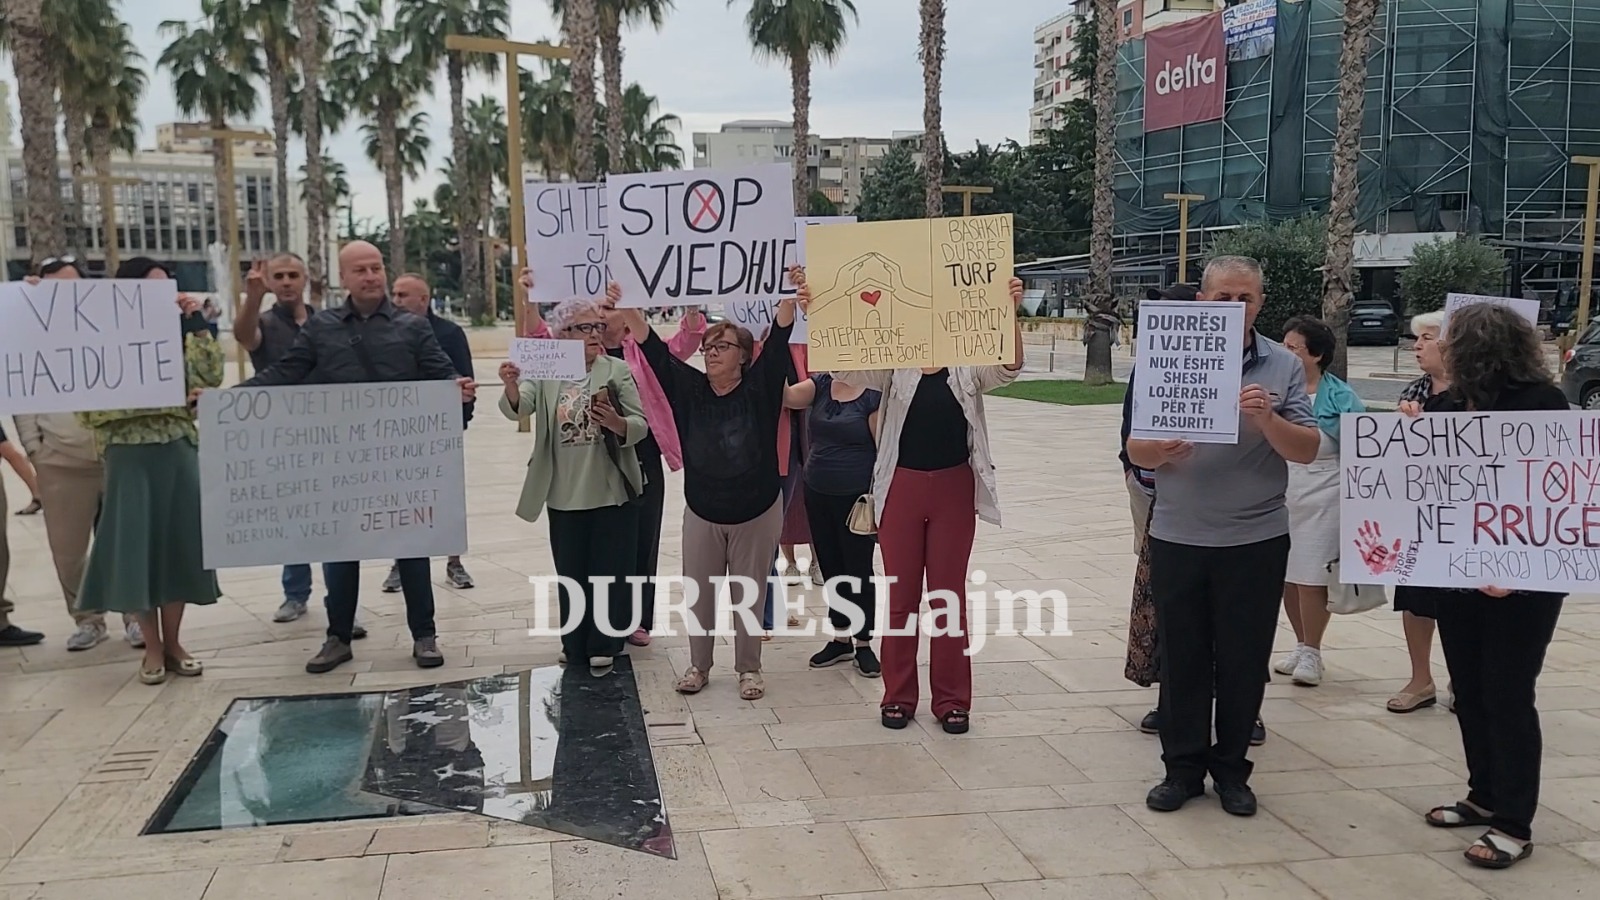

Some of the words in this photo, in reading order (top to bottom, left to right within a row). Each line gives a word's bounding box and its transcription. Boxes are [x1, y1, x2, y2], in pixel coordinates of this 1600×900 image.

[1155, 53, 1216, 95] delta
[619, 178, 763, 236] STOP
[948, 216, 1011, 242] BASHKIA
[624, 238, 797, 299] VJEDHJE
[944, 262, 997, 287] TURP
[938, 305, 1008, 333] VENDIMIN
[1147, 312, 1227, 331] DURRËSI
[860, 347, 894, 364] JETA
[951, 333, 1004, 361] TUAJ!
[1149, 335, 1154, 350] I
[1161, 333, 1227, 352] VJETËR
[5, 340, 173, 397] HAJDUTE
[1149, 357, 1179, 369] NUK
[1183, 355, 1225, 371] ËSHTË
[1163, 371, 1208, 384] SHESH
[217, 390, 272, 425] 200
[283, 391, 330, 415] VJET
[341, 386, 420, 411] HISTORI
[1149, 384, 1218, 400] LOJËRASH
[1161, 400, 1187, 414] PËR
[1190, 400, 1205, 414] TË
[1152, 415, 1214, 429] PASURIT!
[224, 430, 250, 453] PO
[260, 428, 265, 447] I
[349, 425, 367, 443] ME
[1356, 415, 1500, 464] BASHKI,
[1501, 422, 1535, 457] PO
[1545, 421, 1575, 457] NA
[225, 460, 257, 483] NJE
[334, 452, 341, 464] E
[347, 447, 399, 464] VJETER
[403, 443, 425, 459] NUK
[430, 437, 463, 456] ESHTE
[276, 478, 323, 499] ESHTE
[396, 466, 429, 482] KUSH
[436, 465, 444, 478] E
[1345, 465, 1392, 500] NGA
[1405, 464, 1505, 503] BANESAT
[286, 502, 321, 520] VRET
[405, 489, 440, 504] VRET
[299, 520, 340, 539] VRET
[360, 505, 434, 532] JETEN!
[1415, 502, 1457, 544] NË
[1449, 548, 1531, 580] KËRKOJ
